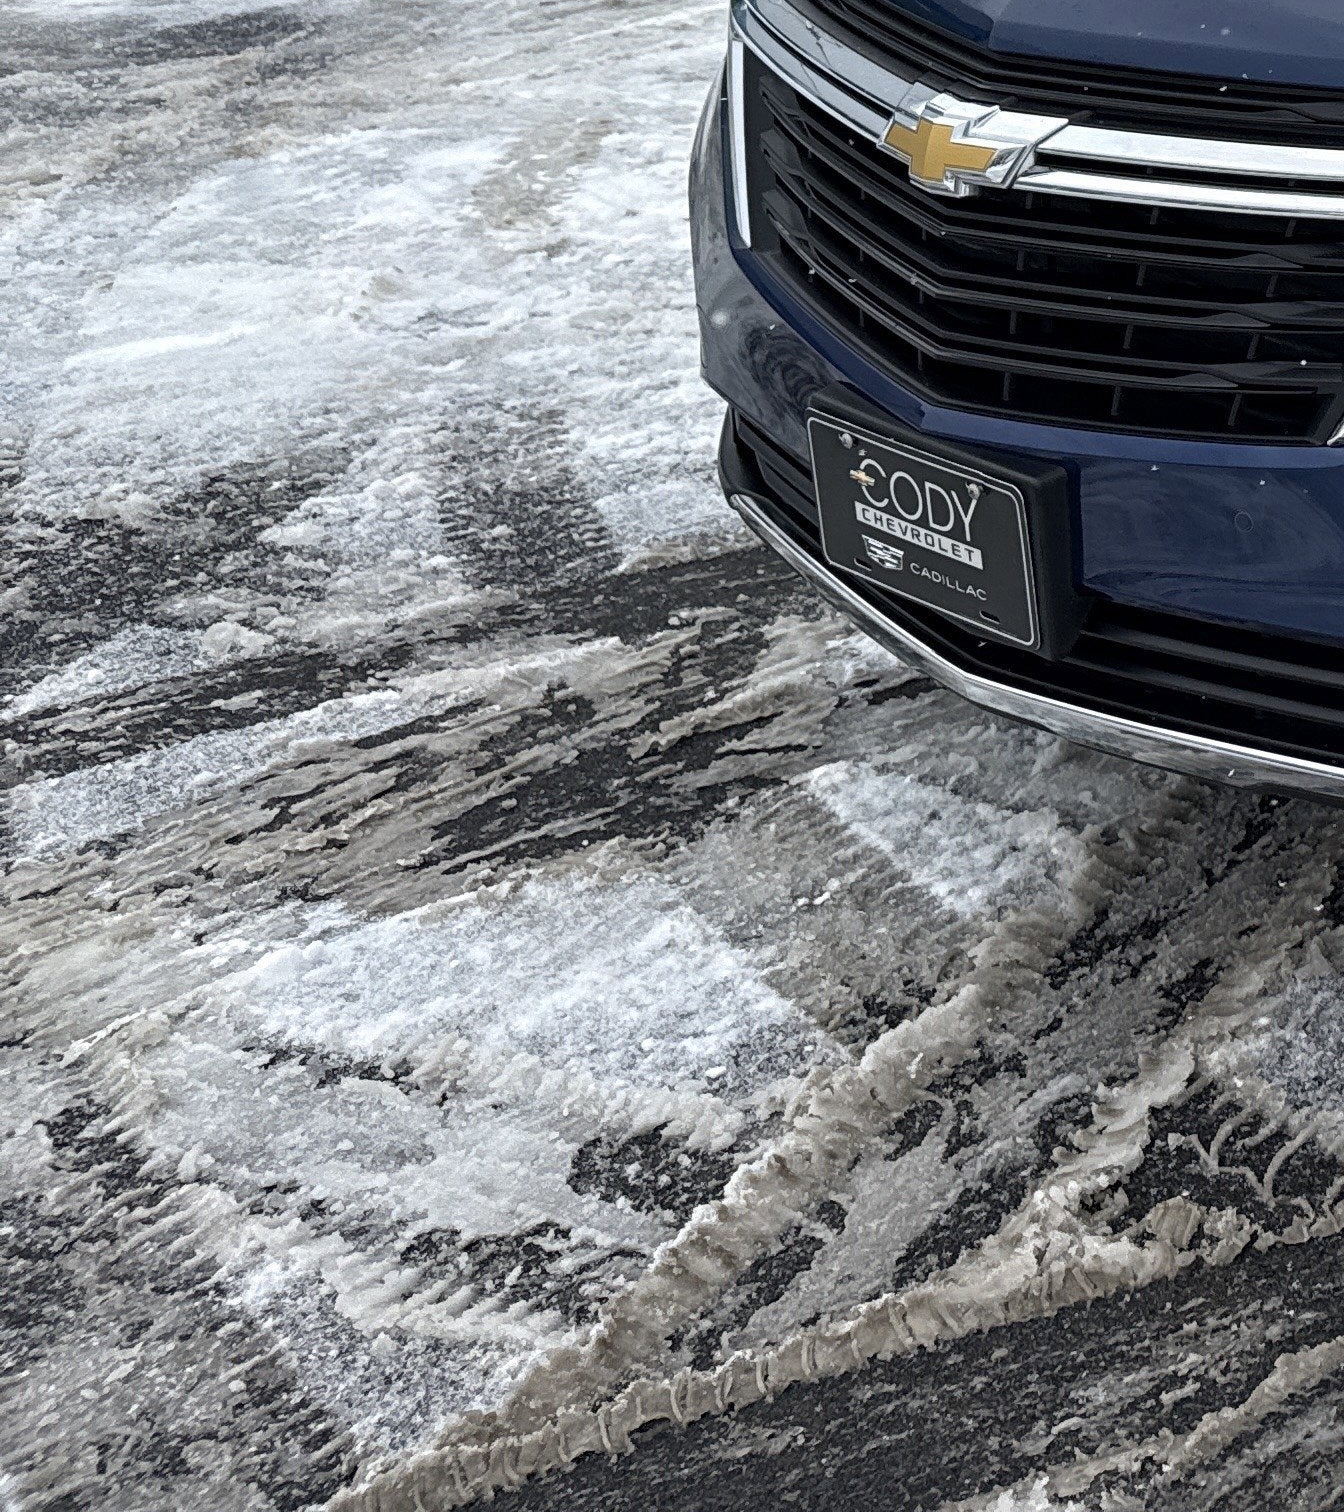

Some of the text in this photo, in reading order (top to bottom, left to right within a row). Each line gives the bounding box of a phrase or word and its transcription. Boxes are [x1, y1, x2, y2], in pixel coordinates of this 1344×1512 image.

[858, 459, 978, 541] CODY
[862, 507, 975, 563] CHEVROLET
[910, 563, 988, 601] CADILLAC
